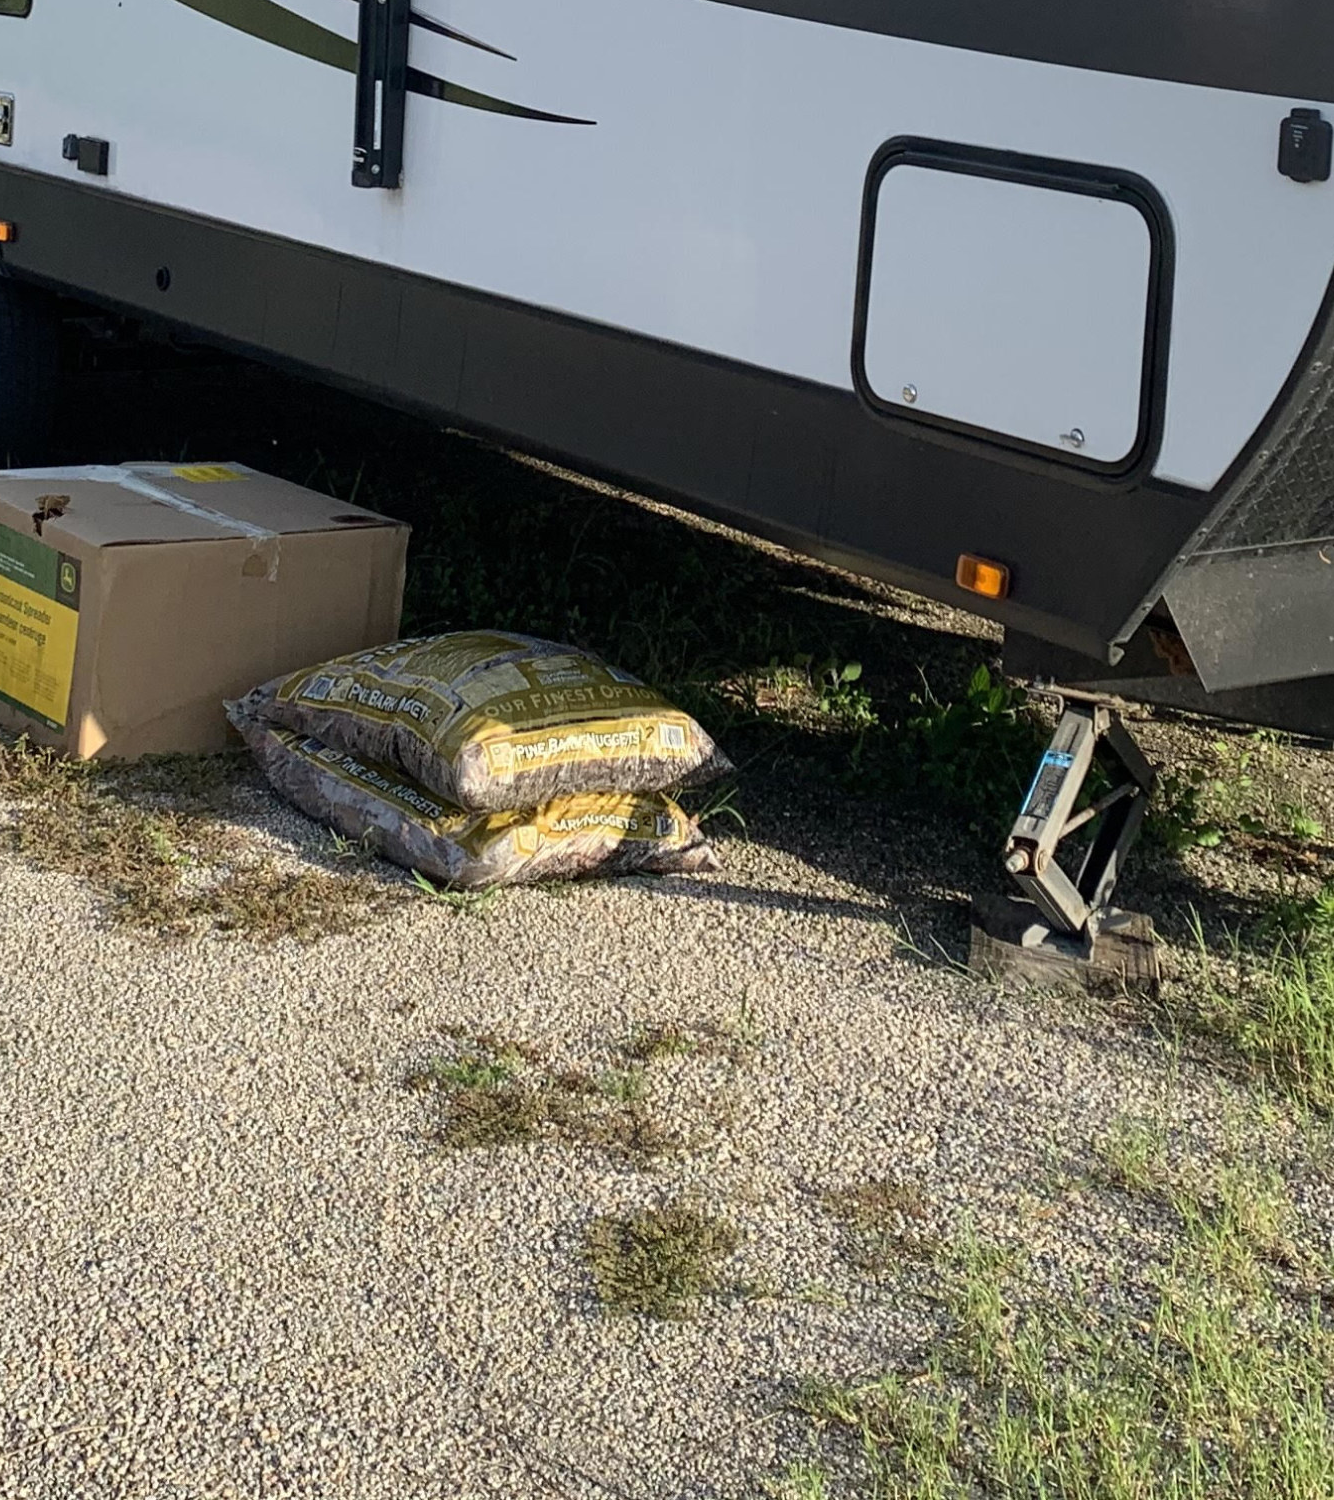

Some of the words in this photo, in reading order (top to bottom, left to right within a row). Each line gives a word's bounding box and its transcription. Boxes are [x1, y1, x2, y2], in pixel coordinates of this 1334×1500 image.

[368, 689, 398, 713] BARK
[484, 700, 525, 717] OUR
[531, 686, 595, 710] FINEST
[515, 741, 545, 759] PINE
[587, 730, 641, 748] NUGGETS
[389, 784, 444, 818] NUGGETS
[581, 813, 638, 830] NUGGETS
[642, 815, 653, 827] 2
